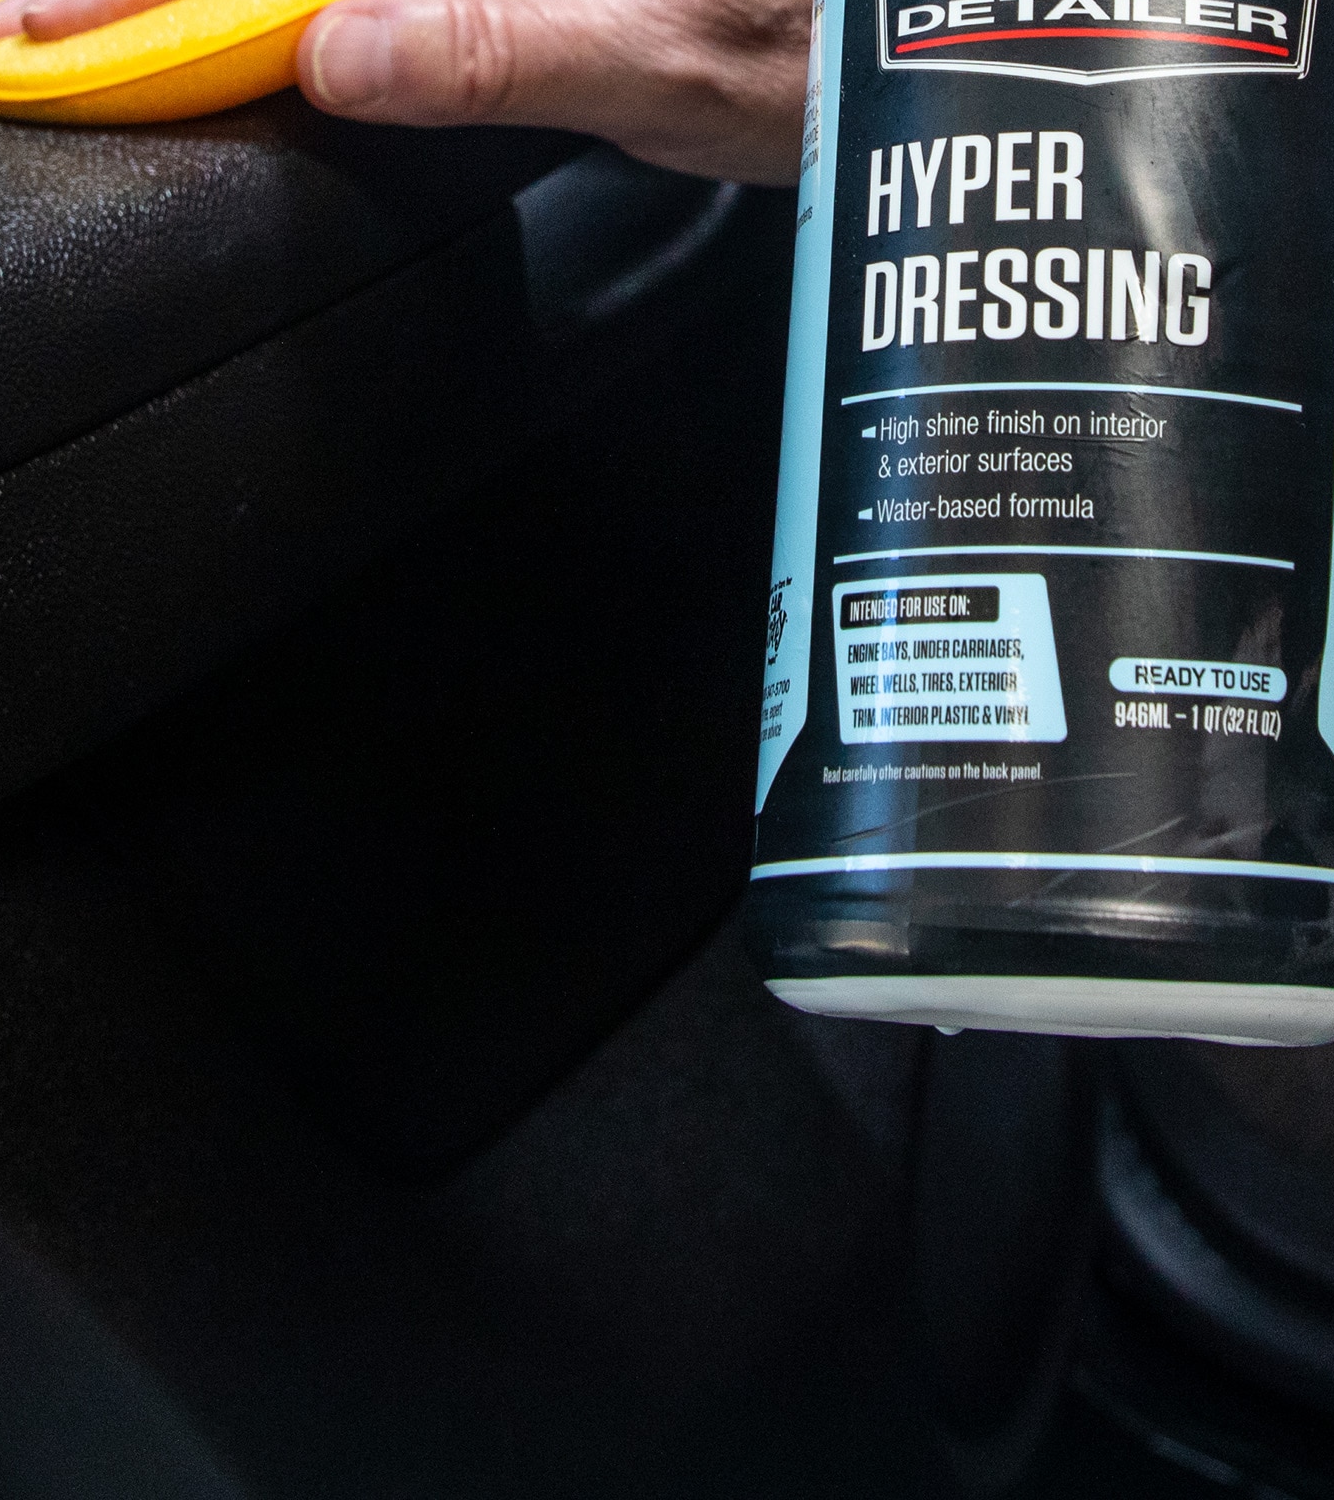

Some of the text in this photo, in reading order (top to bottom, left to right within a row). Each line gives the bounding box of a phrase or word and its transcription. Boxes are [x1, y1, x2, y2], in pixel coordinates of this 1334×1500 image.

[867, 130, 1085, 237] HYPER
[861, 246, 1213, 352] DRESSING
[880, 410, 1168, 445] High shine finish on interior
[877, 446, 1073, 479] & exterior surfaces
[876, 492, 1095, 523] Water-based formula
[849, 594, 971, 623] INTENDED FOR USE ON:
[847, 638, 1025, 665] ENGINE BAYS, UNDER CARRIAGES,
[850, 671, 1018, 696] WHEEL WELLS, TIRES, EXTERIOR
[1134, 665, 1270, 692] READY TO USE
[853, 704, 1031, 729] TRIM, INTERIOR PLASTIC & VINYL
[1115, 701, 1172, 729] 946ML
[1191, 704, 1199, 731] 1
[1246, 708, 1259, 735] FL
[1261, 709, 1282, 742] OZ)
[823, 762, 1044, 785] Read carefully other cautions on the back panel.
